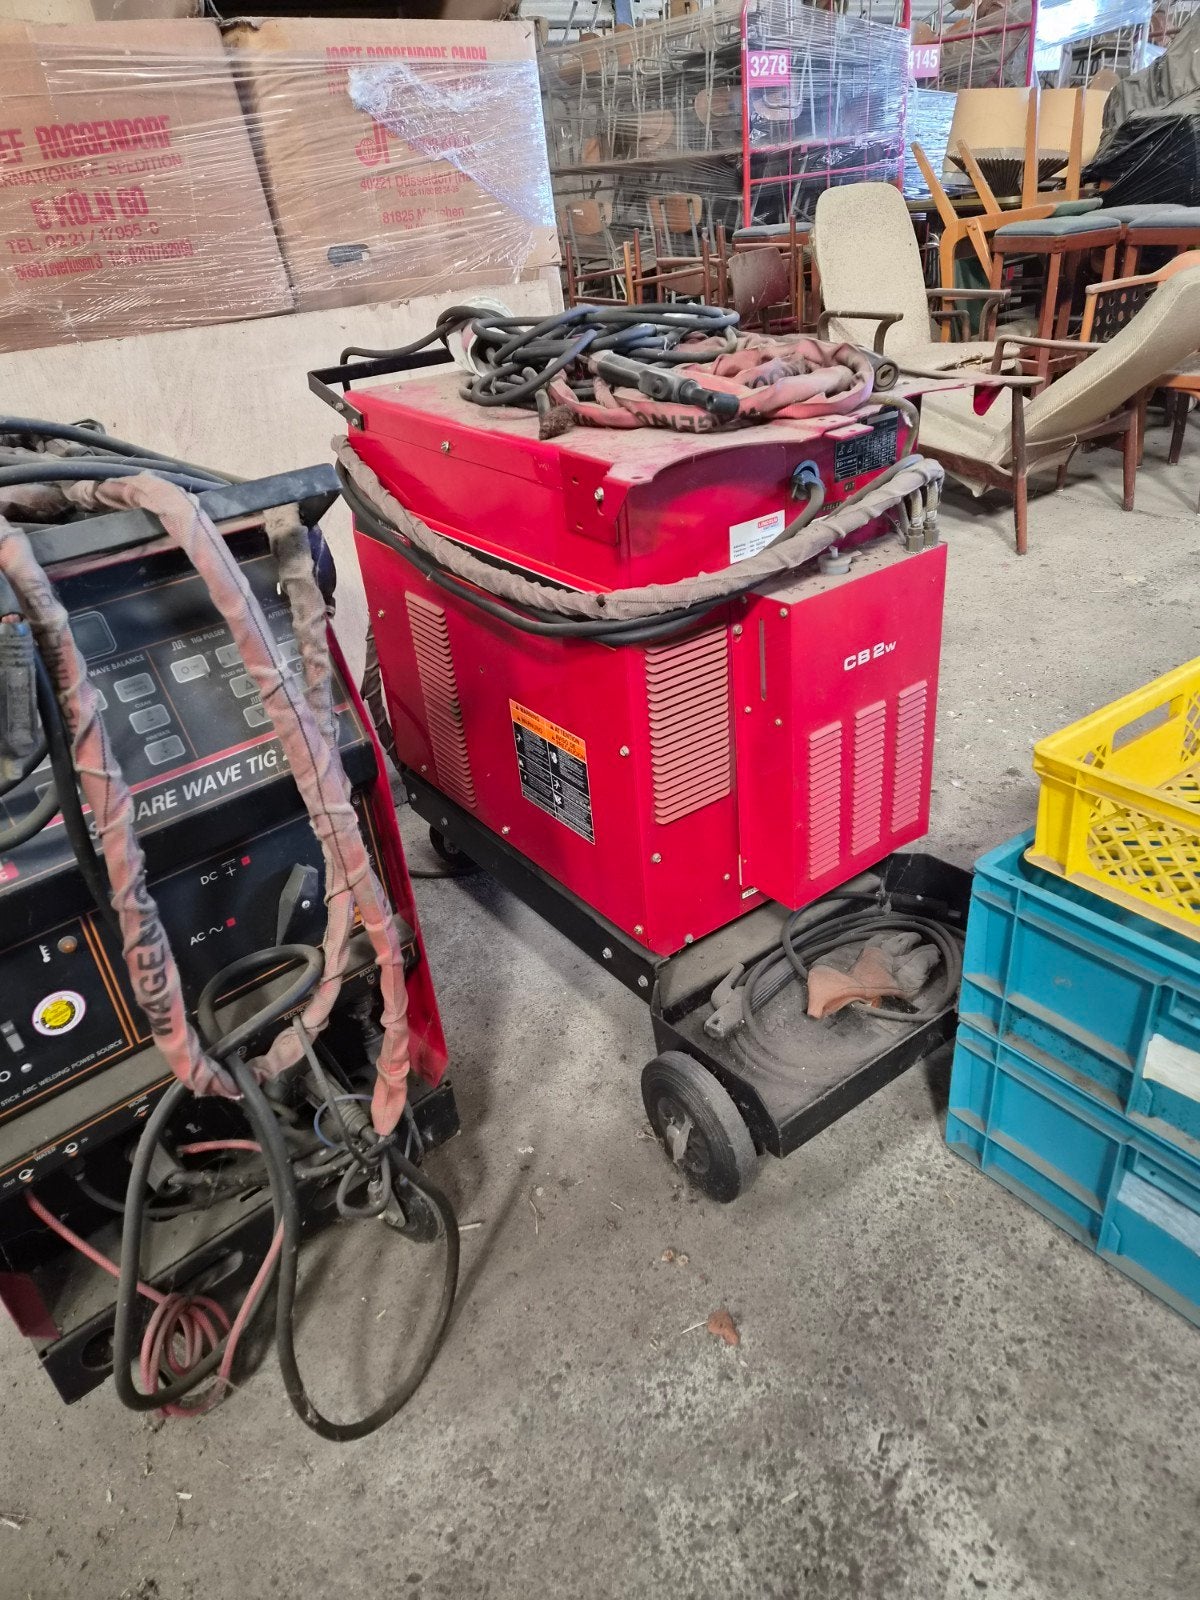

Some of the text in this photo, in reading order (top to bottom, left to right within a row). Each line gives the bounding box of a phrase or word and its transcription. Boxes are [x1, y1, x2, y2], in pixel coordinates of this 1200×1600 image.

[750, 55, 787, 77] 3278
[34, 115, 173, 161] ROGGENDORF
[54, 187, 117, 228] KÖLN
[382, 206, 464, 224] 81825 Mchen
[88, 654, 146, 677] WAVE BALANCE
[182, 763, 243, 801] WAVE
[246, 749, 278, 775] TIG
[200, 871, 219, 885] DC
[190, 932, 206, 946] AC
[0, 1039, 122, 1106] STICK ARC WELDING POWER SOURCE
